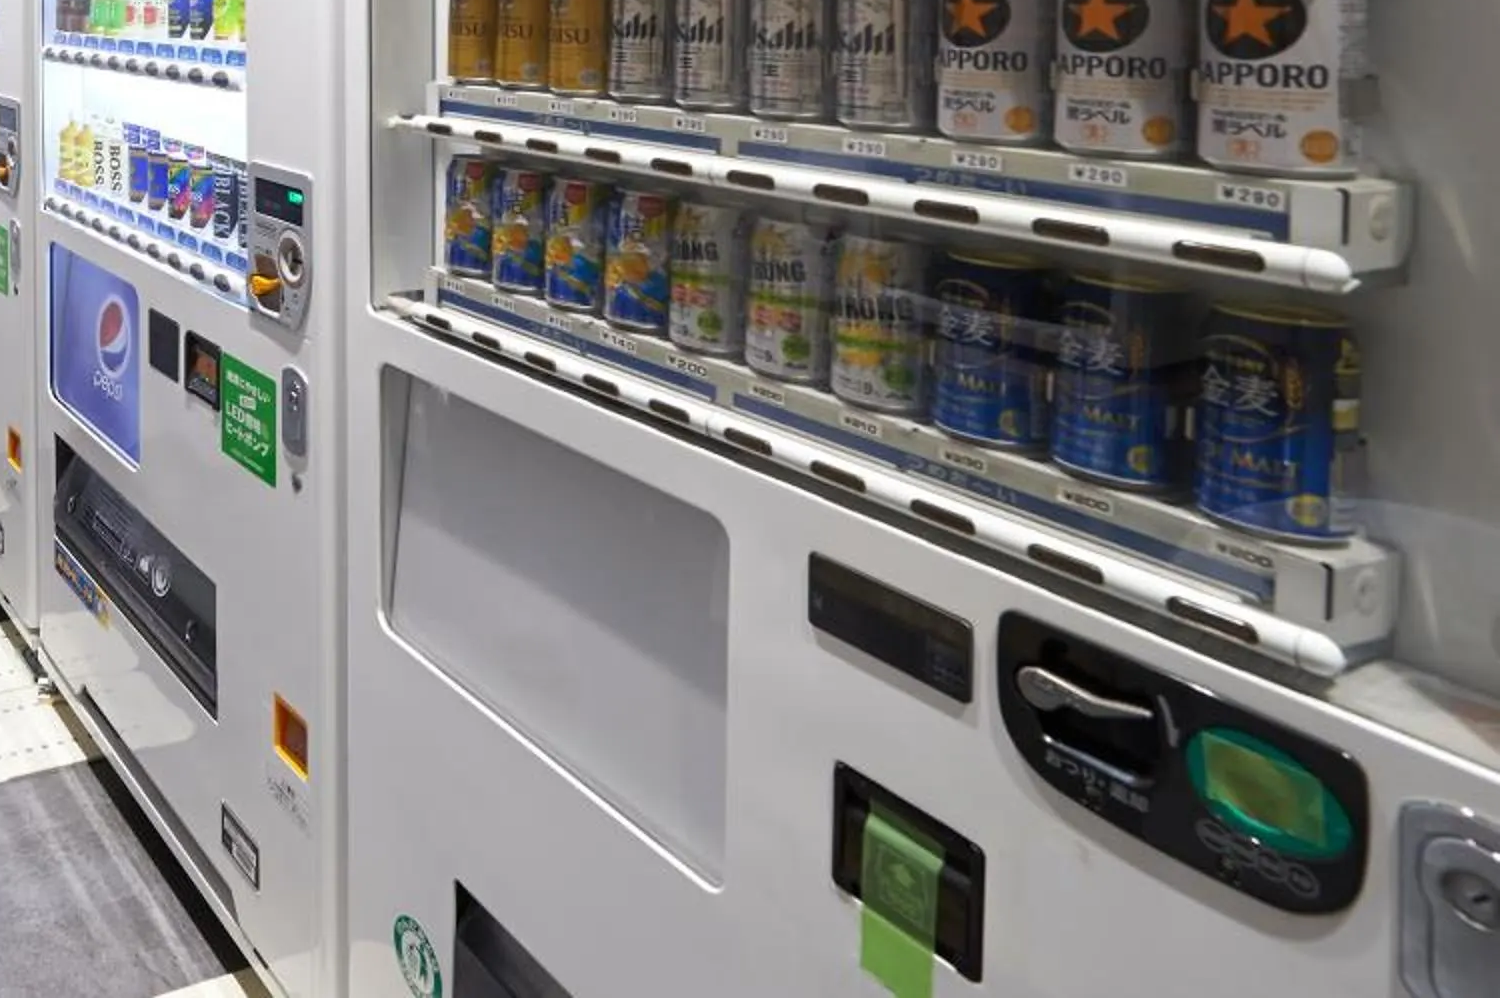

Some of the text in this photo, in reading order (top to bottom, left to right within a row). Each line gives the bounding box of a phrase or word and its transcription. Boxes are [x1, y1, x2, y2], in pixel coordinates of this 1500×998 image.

[1057, 55, 1167, 80] APPORO
[1202, 62, 1329, 90] APPORO
[110, 145, 122, 191] BOSS
[1202, 363, 1280, 418] 金麦
